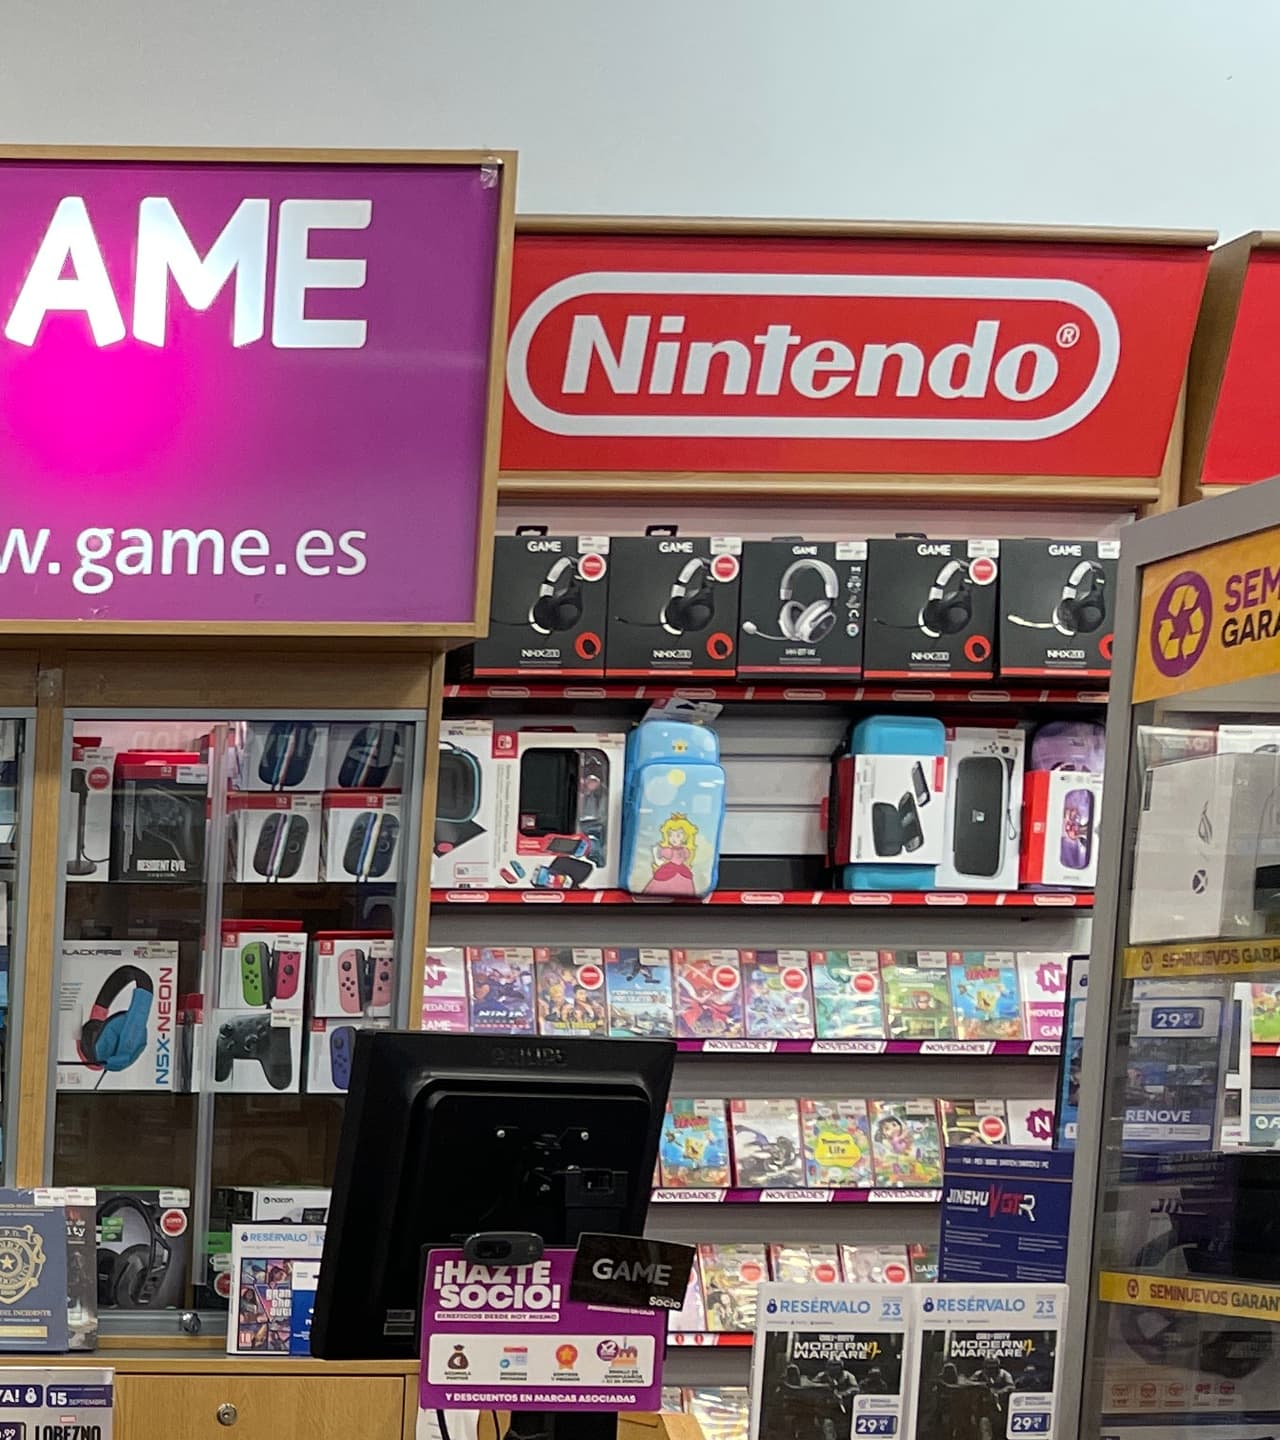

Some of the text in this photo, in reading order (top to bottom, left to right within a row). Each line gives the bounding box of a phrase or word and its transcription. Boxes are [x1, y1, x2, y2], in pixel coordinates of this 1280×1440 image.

[561, 315, 1059, 401] Nintendo
[527, 541, 561, 553] GAME
[918, 544, 951, 556] GAME
[155, 967, 173, 1085] NSX-NEON
[708, 1041, 770, 1052] NOVEDADES
[947, 1188, 989, 1209] JINSHU
[435, 1261, 551, 1289] ¡HAZTE
[592, 1258, 672, 1286] GAME
[440, 1284, 560, 1310] SOCIO!
[649, 1296, 681, 1309] Socio
[780, 1298, 901, 1317] RESÉRVALO 23
[1150, 1283, 1280, 1312] SEMINUEVOS GARAN
[445, 1393, 636, 1403] Y DESCUENTOS EN MARCAS ASOCIADAS
